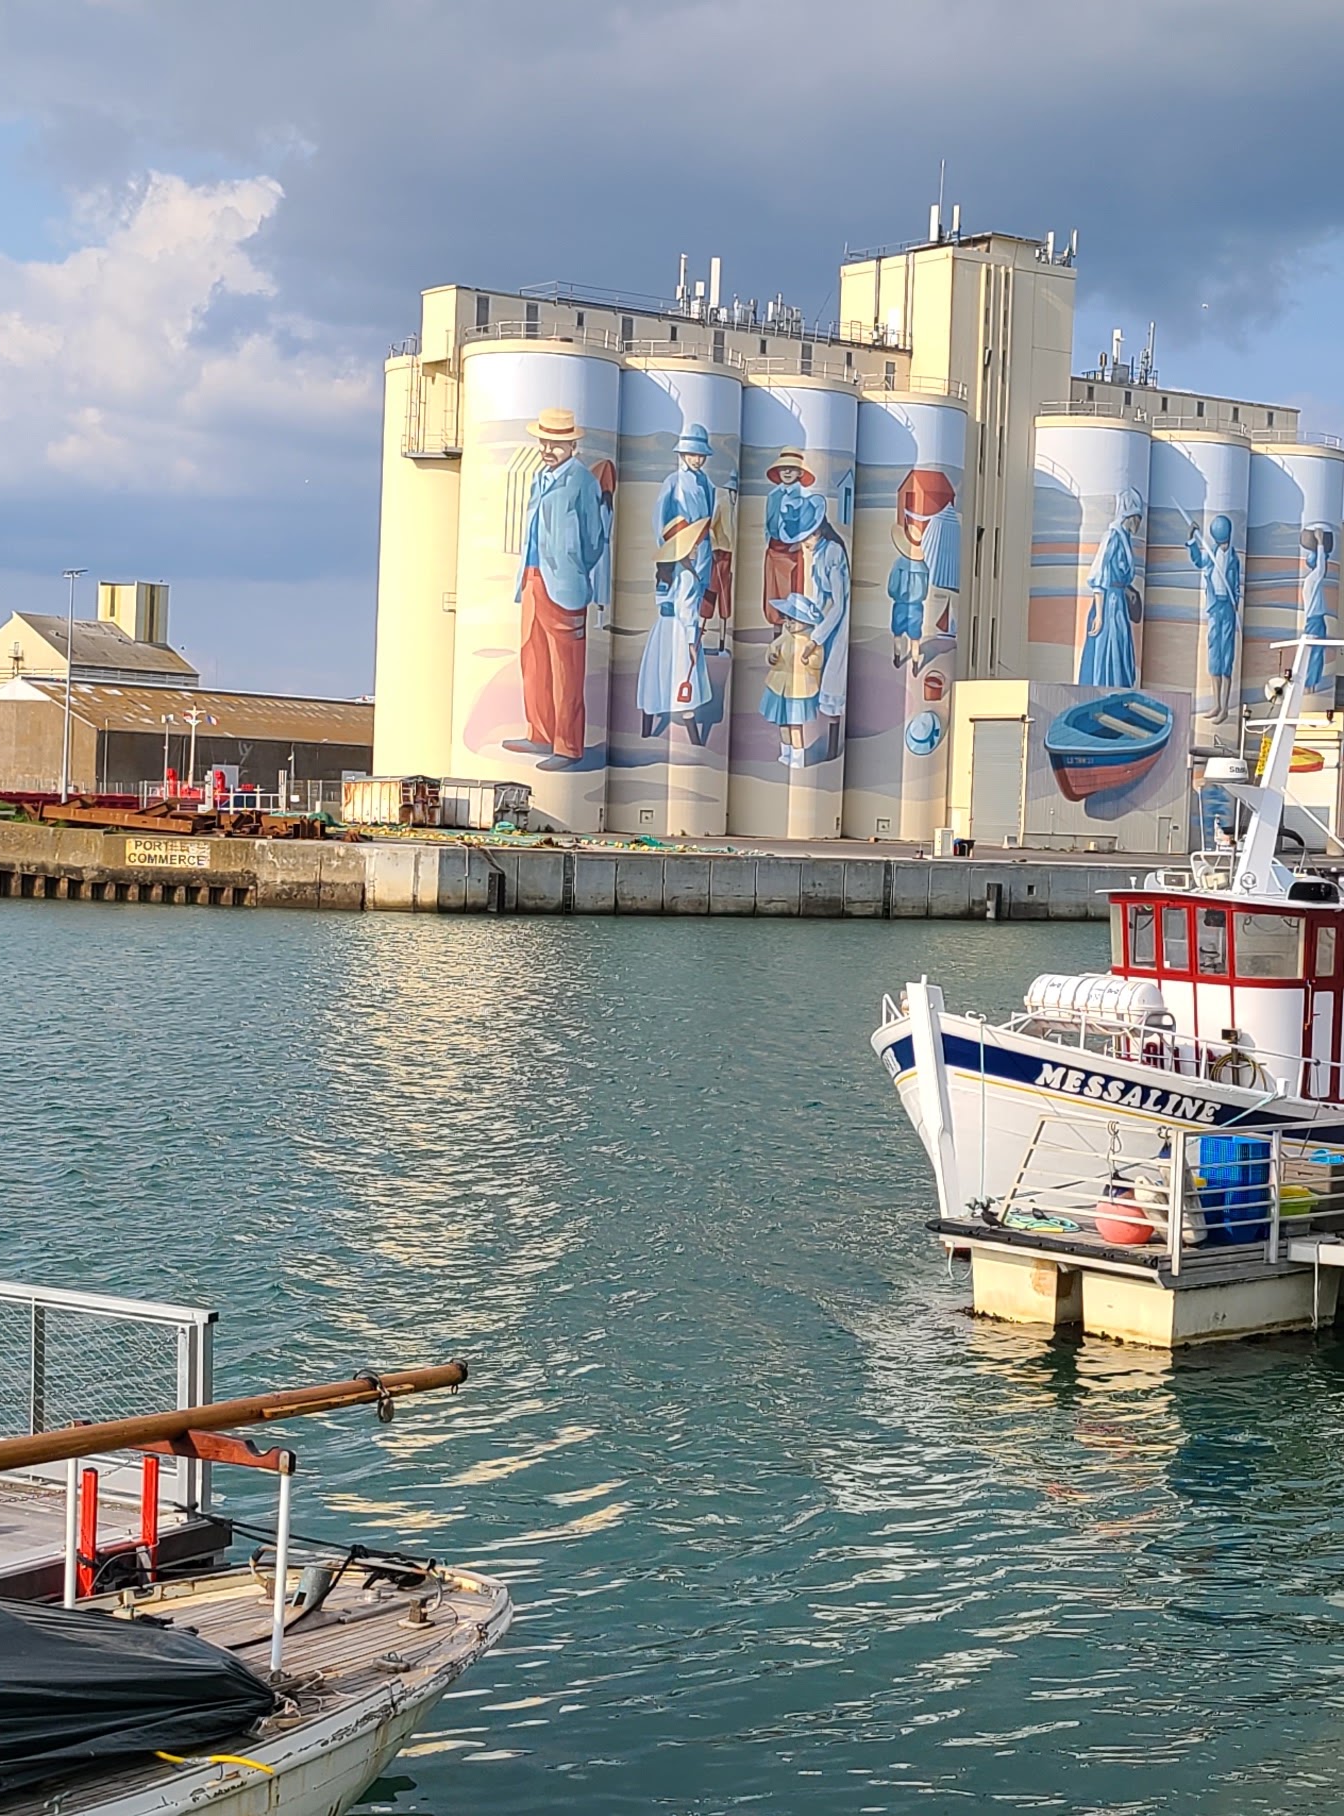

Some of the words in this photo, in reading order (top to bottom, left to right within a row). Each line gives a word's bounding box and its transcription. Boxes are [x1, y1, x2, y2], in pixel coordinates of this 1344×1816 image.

[134, 840, 169, 851] PORT
[128, 853, 206, 866] COMMERCE
[1035, 1063, 1221, 1122] MESSALINE
